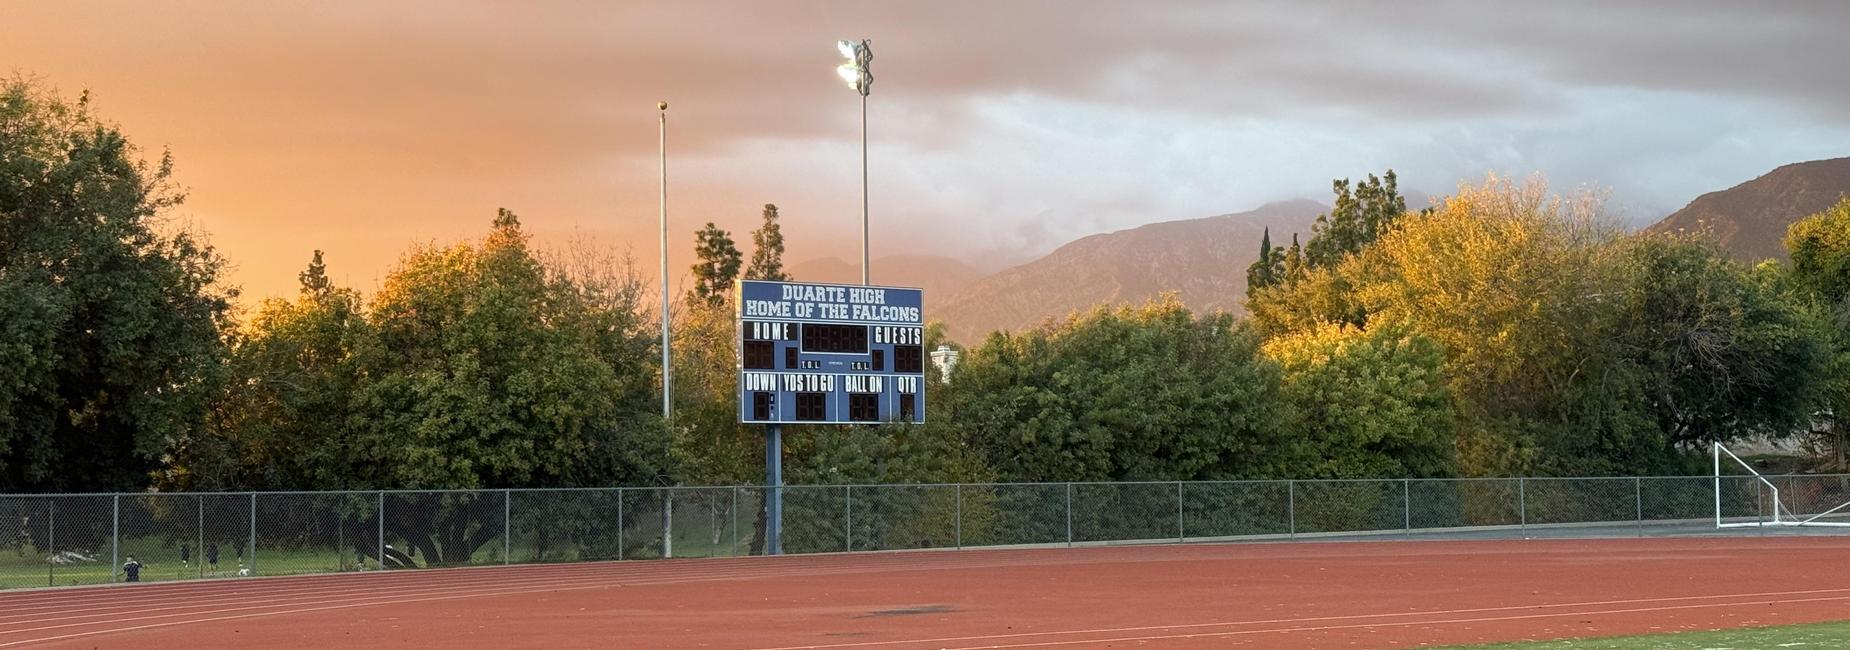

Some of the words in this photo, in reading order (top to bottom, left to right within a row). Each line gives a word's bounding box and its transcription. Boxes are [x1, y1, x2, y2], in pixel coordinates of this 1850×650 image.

[782, 284, 846, 302] DUARTE
[849, 288, 886, 305] HIGH
[746, 300, 792, 317] HOME
[795, 302, 815, 318] OF
[818, 303, 849, 320] THE
[852, 304, 919, 322] FALCONS
[753, 322, 789, 341] HOME
[875, 326, 921, 345] GUESTS
[746, 373, 776, 391] DOWN
[783, 374, 803, 391] YDS
[806, 374, 818, 392] TO
[820, 375, 834, 392] GO
[845, 375, 867, 393] BALL
[869, 376, 883, 393] ON
[898, 376, 917, 393] QTR
